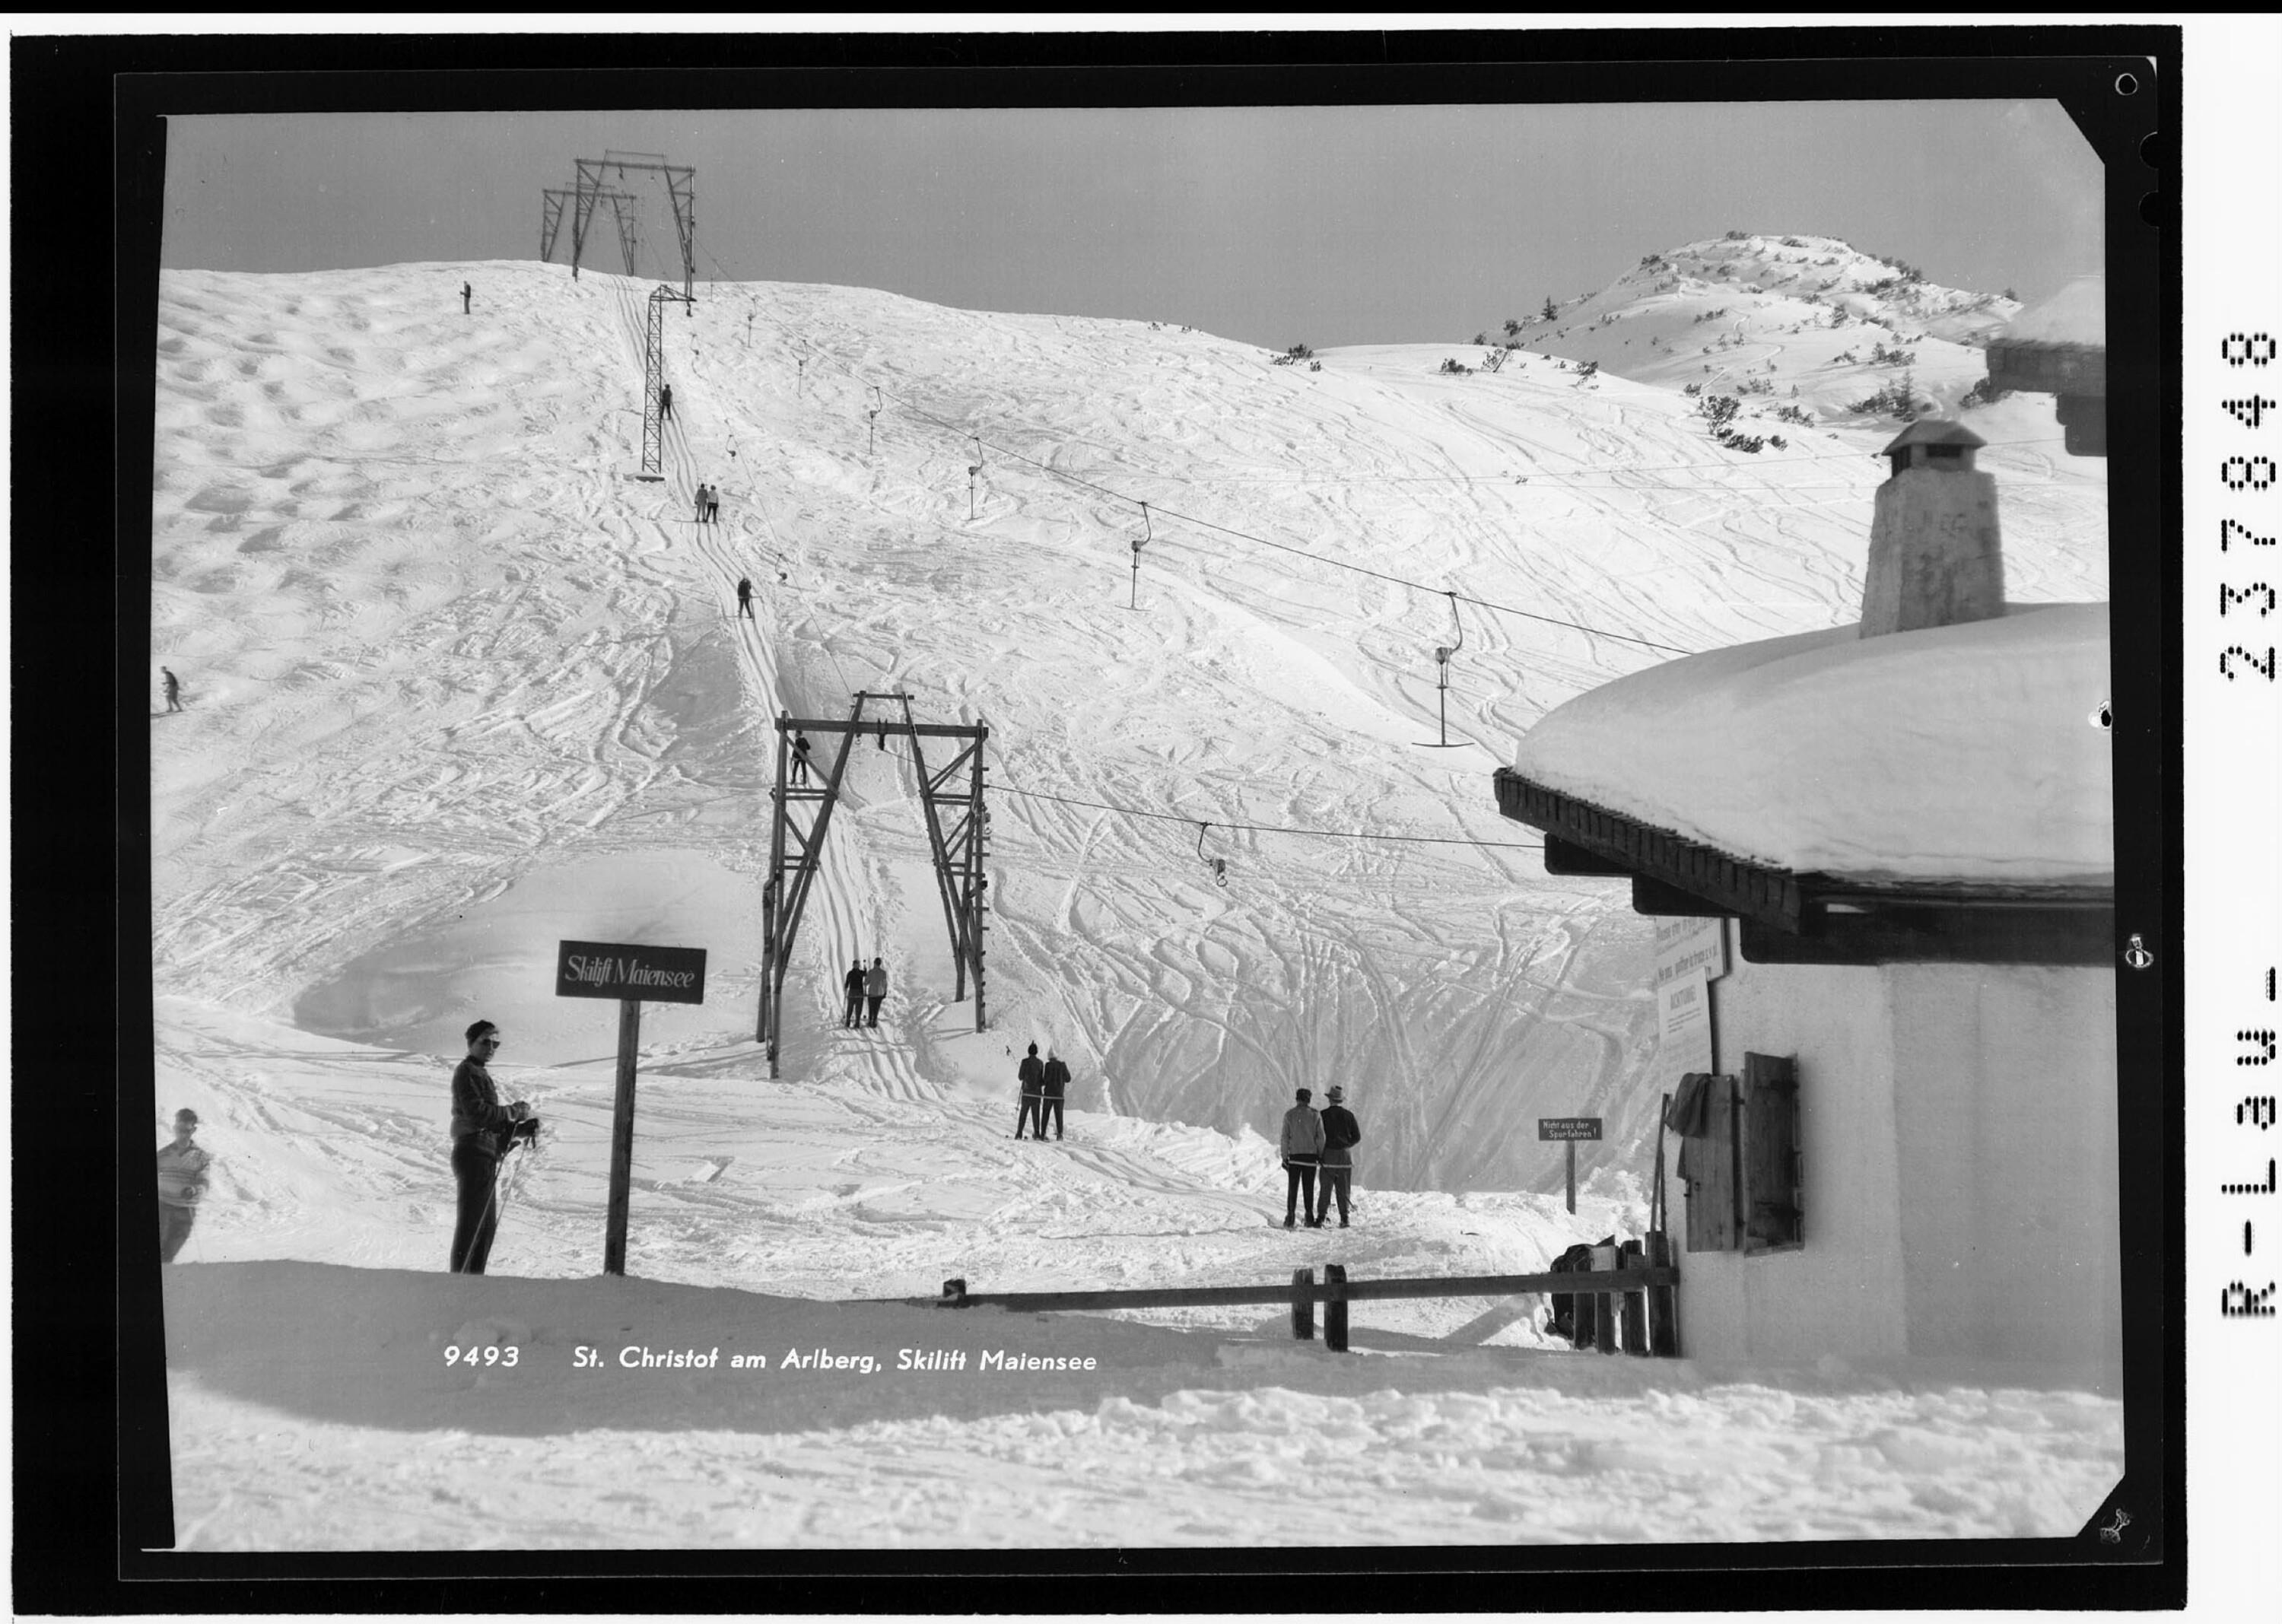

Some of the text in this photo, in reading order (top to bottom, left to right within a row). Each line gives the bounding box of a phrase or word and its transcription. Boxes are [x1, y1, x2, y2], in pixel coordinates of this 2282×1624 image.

[565, 955, 694, 988] Skilift Maiensee
[1576, 1120, 1589, 1130] der
